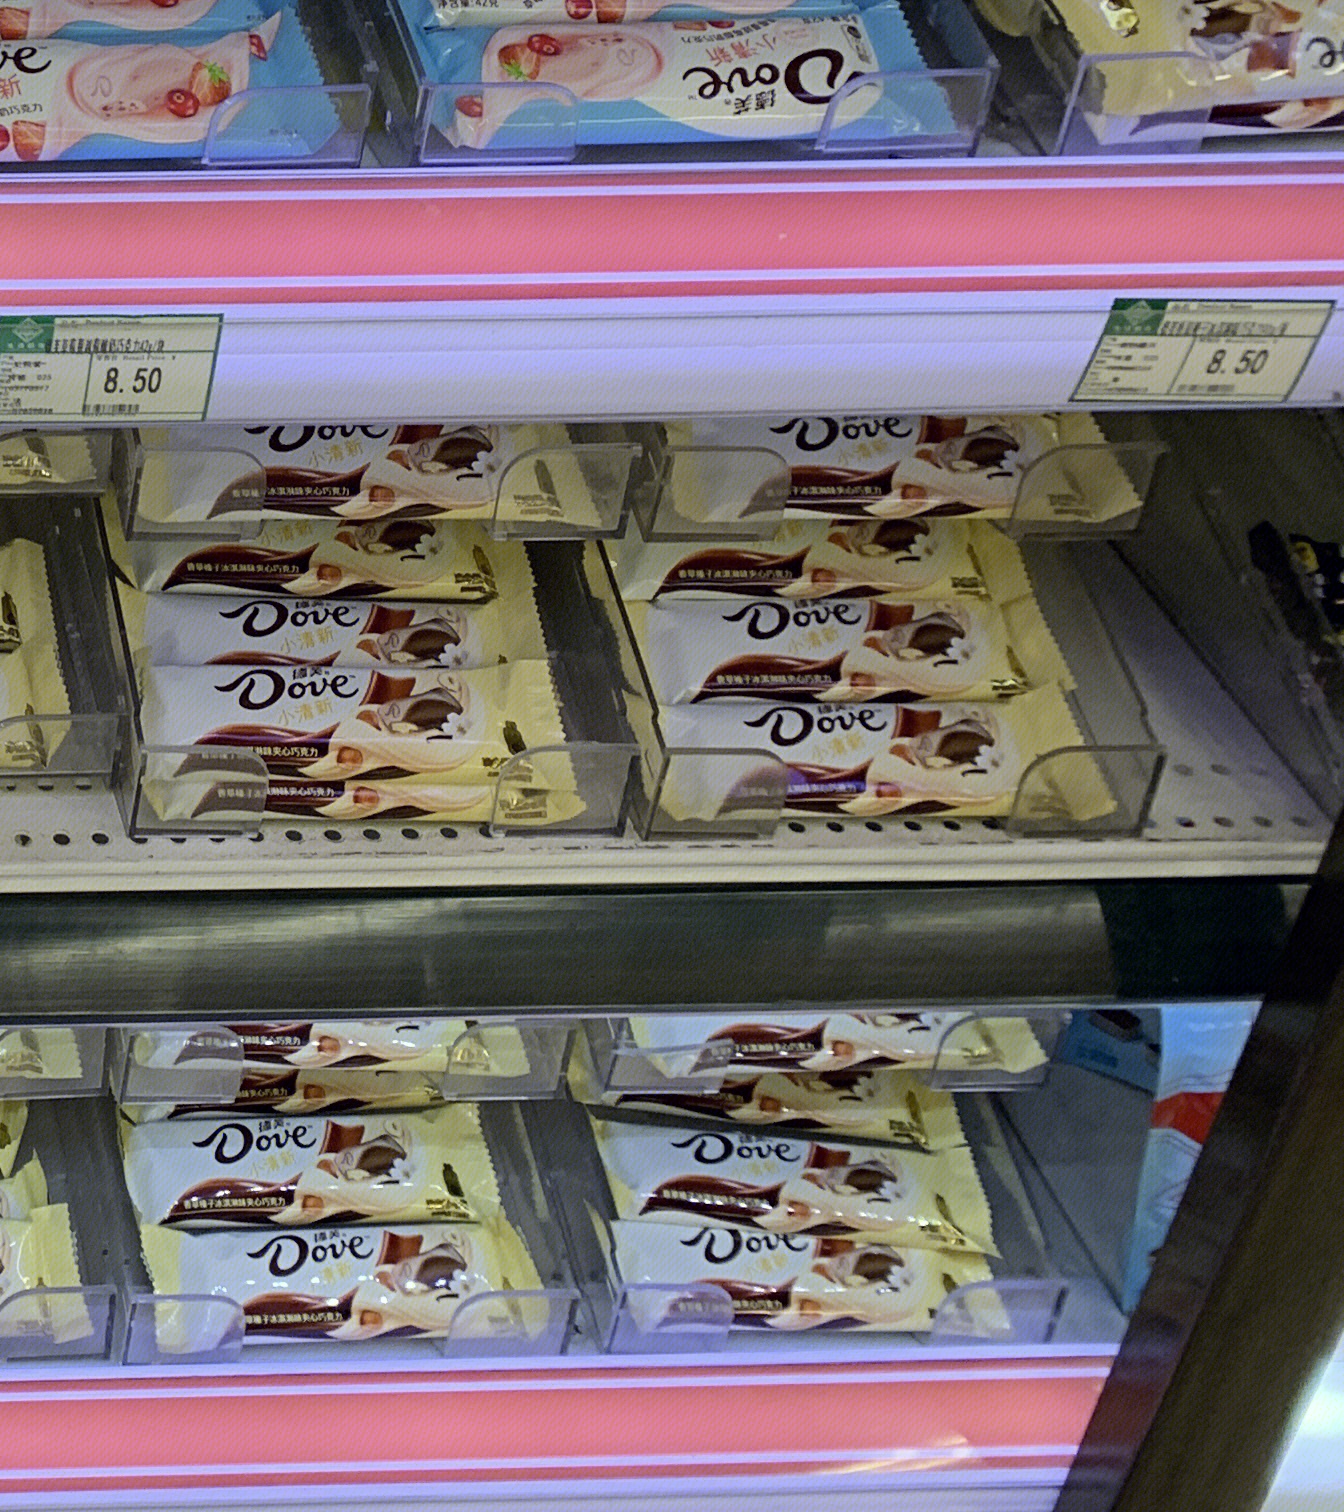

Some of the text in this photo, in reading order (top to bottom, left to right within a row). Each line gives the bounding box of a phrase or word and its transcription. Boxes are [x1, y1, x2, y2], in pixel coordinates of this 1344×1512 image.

[103, 367, 162, 393] 8.50
[1206, 350, 1270, 374] 8.50
[219, 601, 360, 638] Dove
[214, 669, 360, 710] Dove
[192, 1122, 317, 1164] Dove
[247, 1235, 373, 1277] Dove
